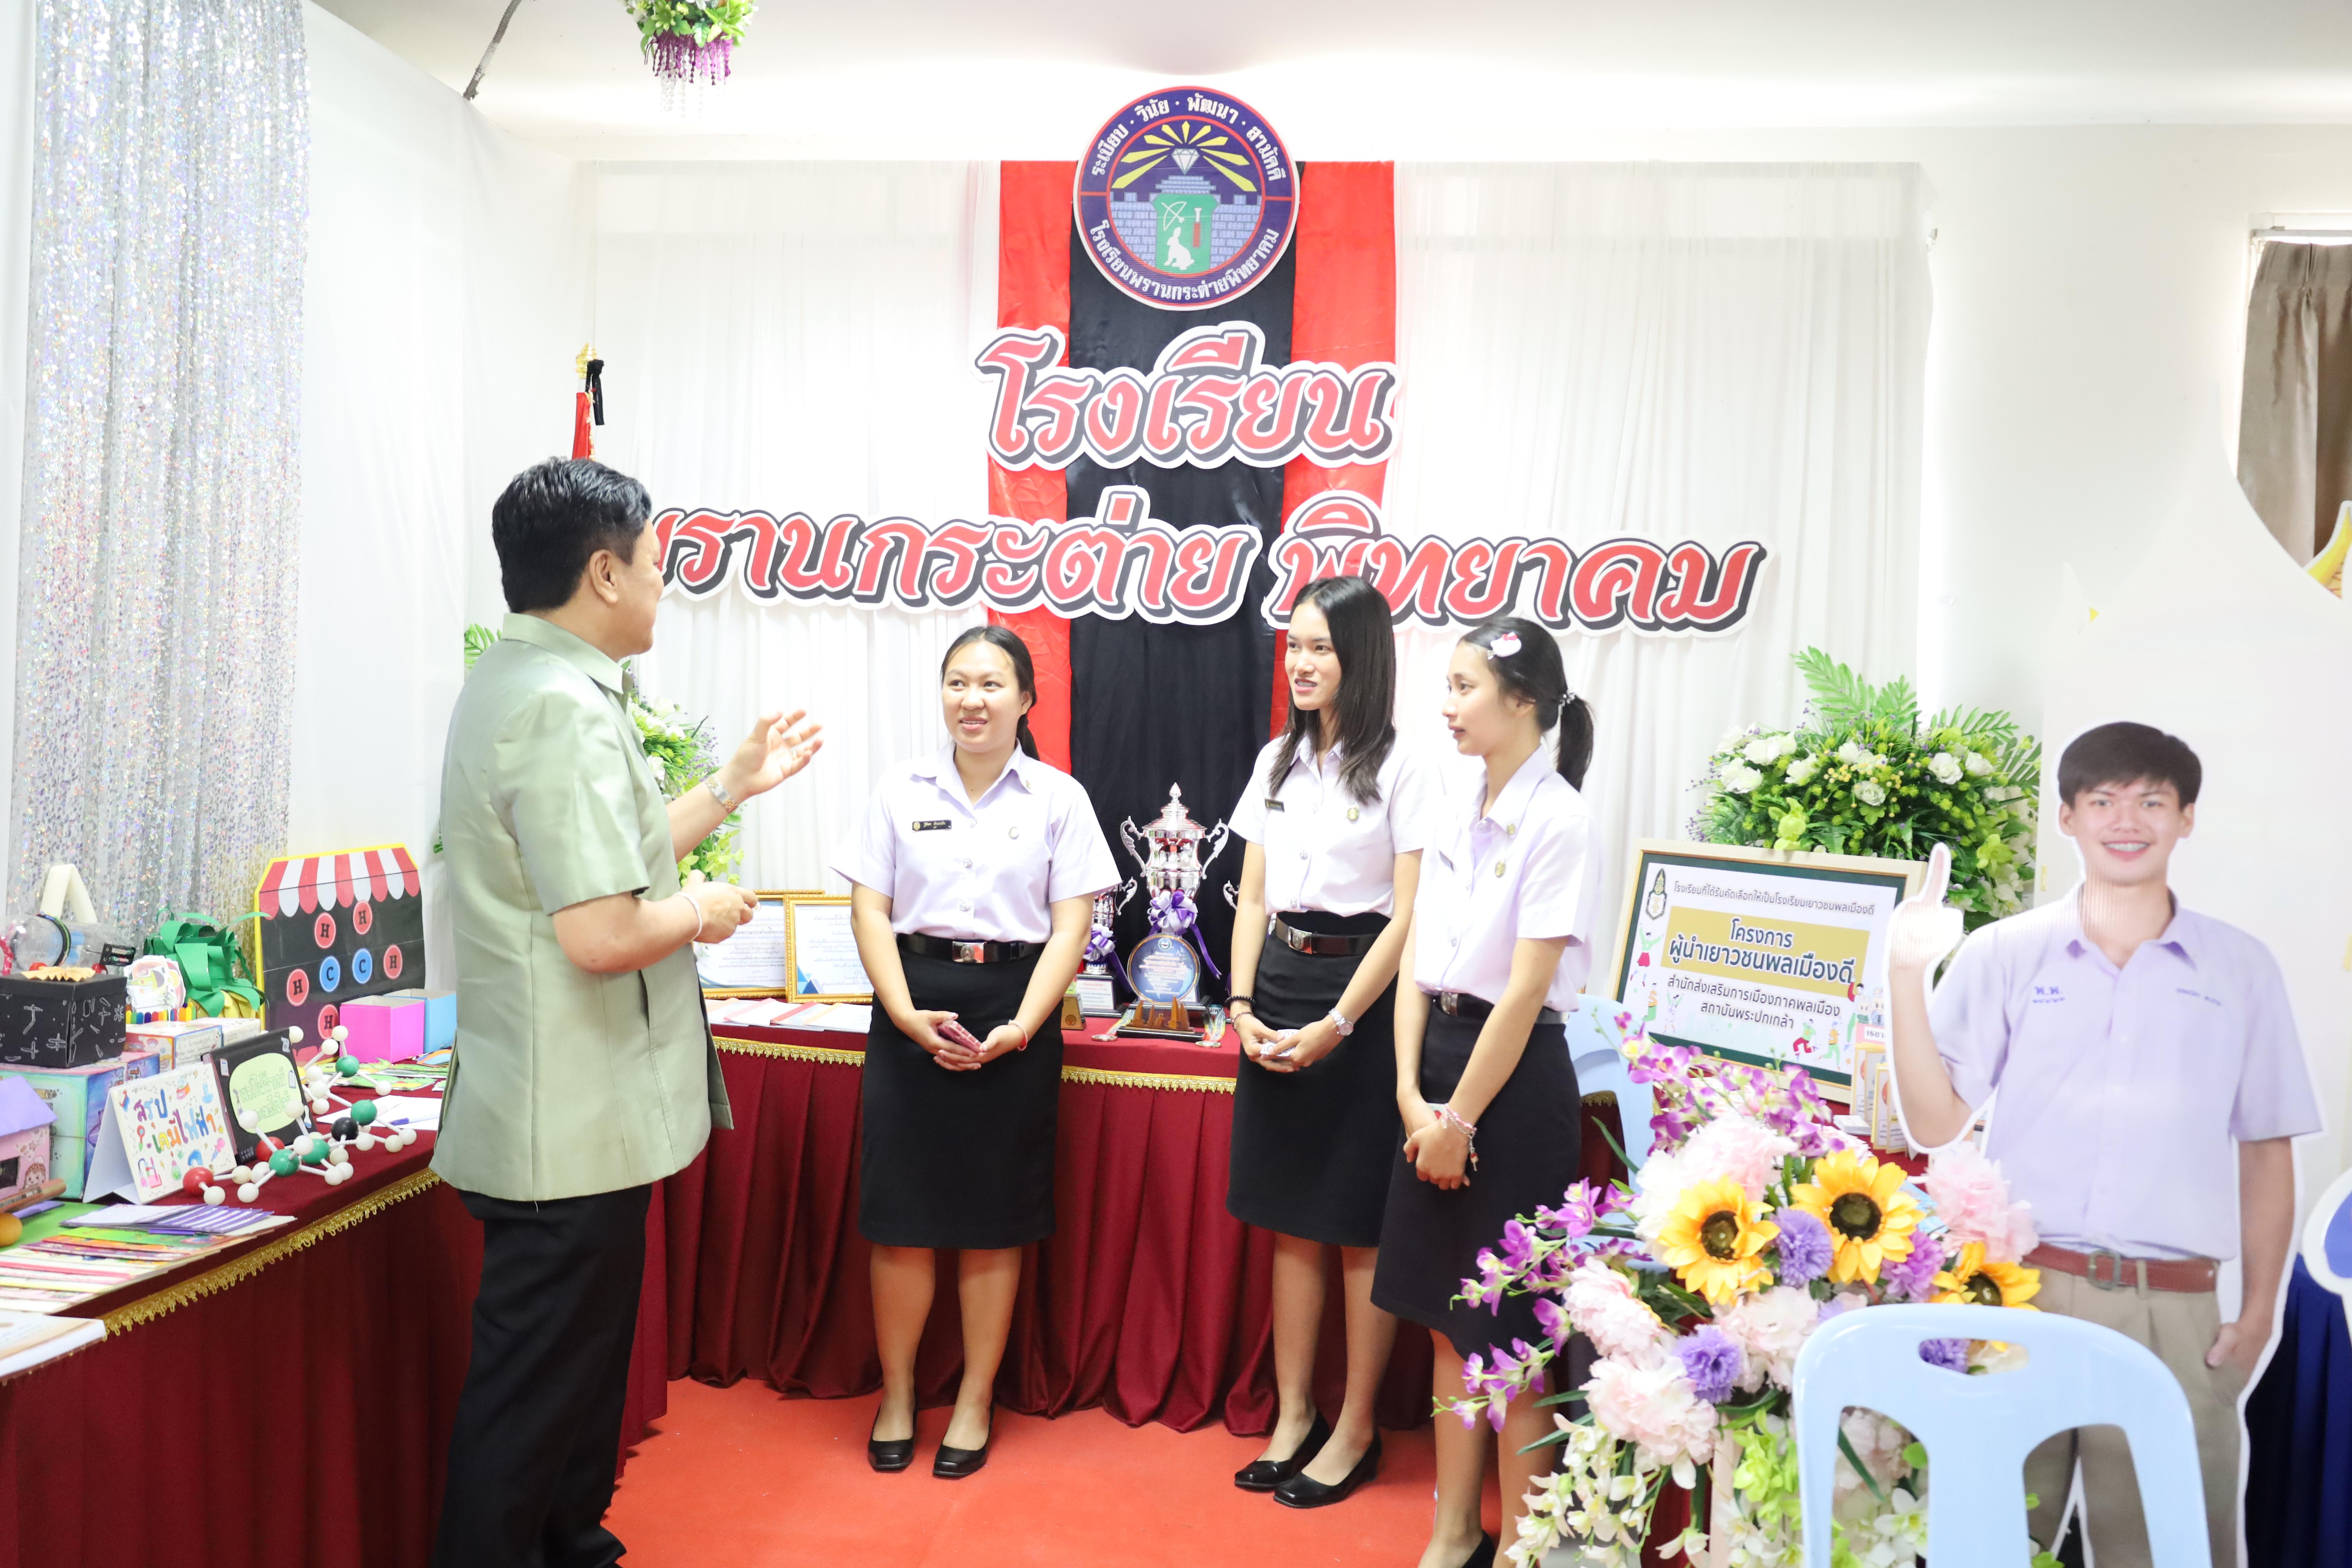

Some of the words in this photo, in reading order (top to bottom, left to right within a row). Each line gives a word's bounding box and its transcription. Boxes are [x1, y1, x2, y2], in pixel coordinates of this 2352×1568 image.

[1092, 124, 1129, 176] ระเบียบ
[1134, 99, 1170, 122] วินัย
[1187, 92, 1239, 124] พัฒนา
[1246, 126, 1286, 181] สามัคคี
[1090, 219, 1280, 300] โรงเรียนพรานกระต่ายพิทยาคม
[977, 329, 1396, 466] โรงเรียน
[1730, 918, 1793, 948] โครงการ
[1670, 934, 1855, 984] ผู้นำเยาวชนพลเมืองดี
[1668, 974, 1840, 1017] สำนักส่งเสริมการเมืองภาคพลเมือง
[1701, 1002, 1794, 1029] สถาบันพระปกเกล้า
